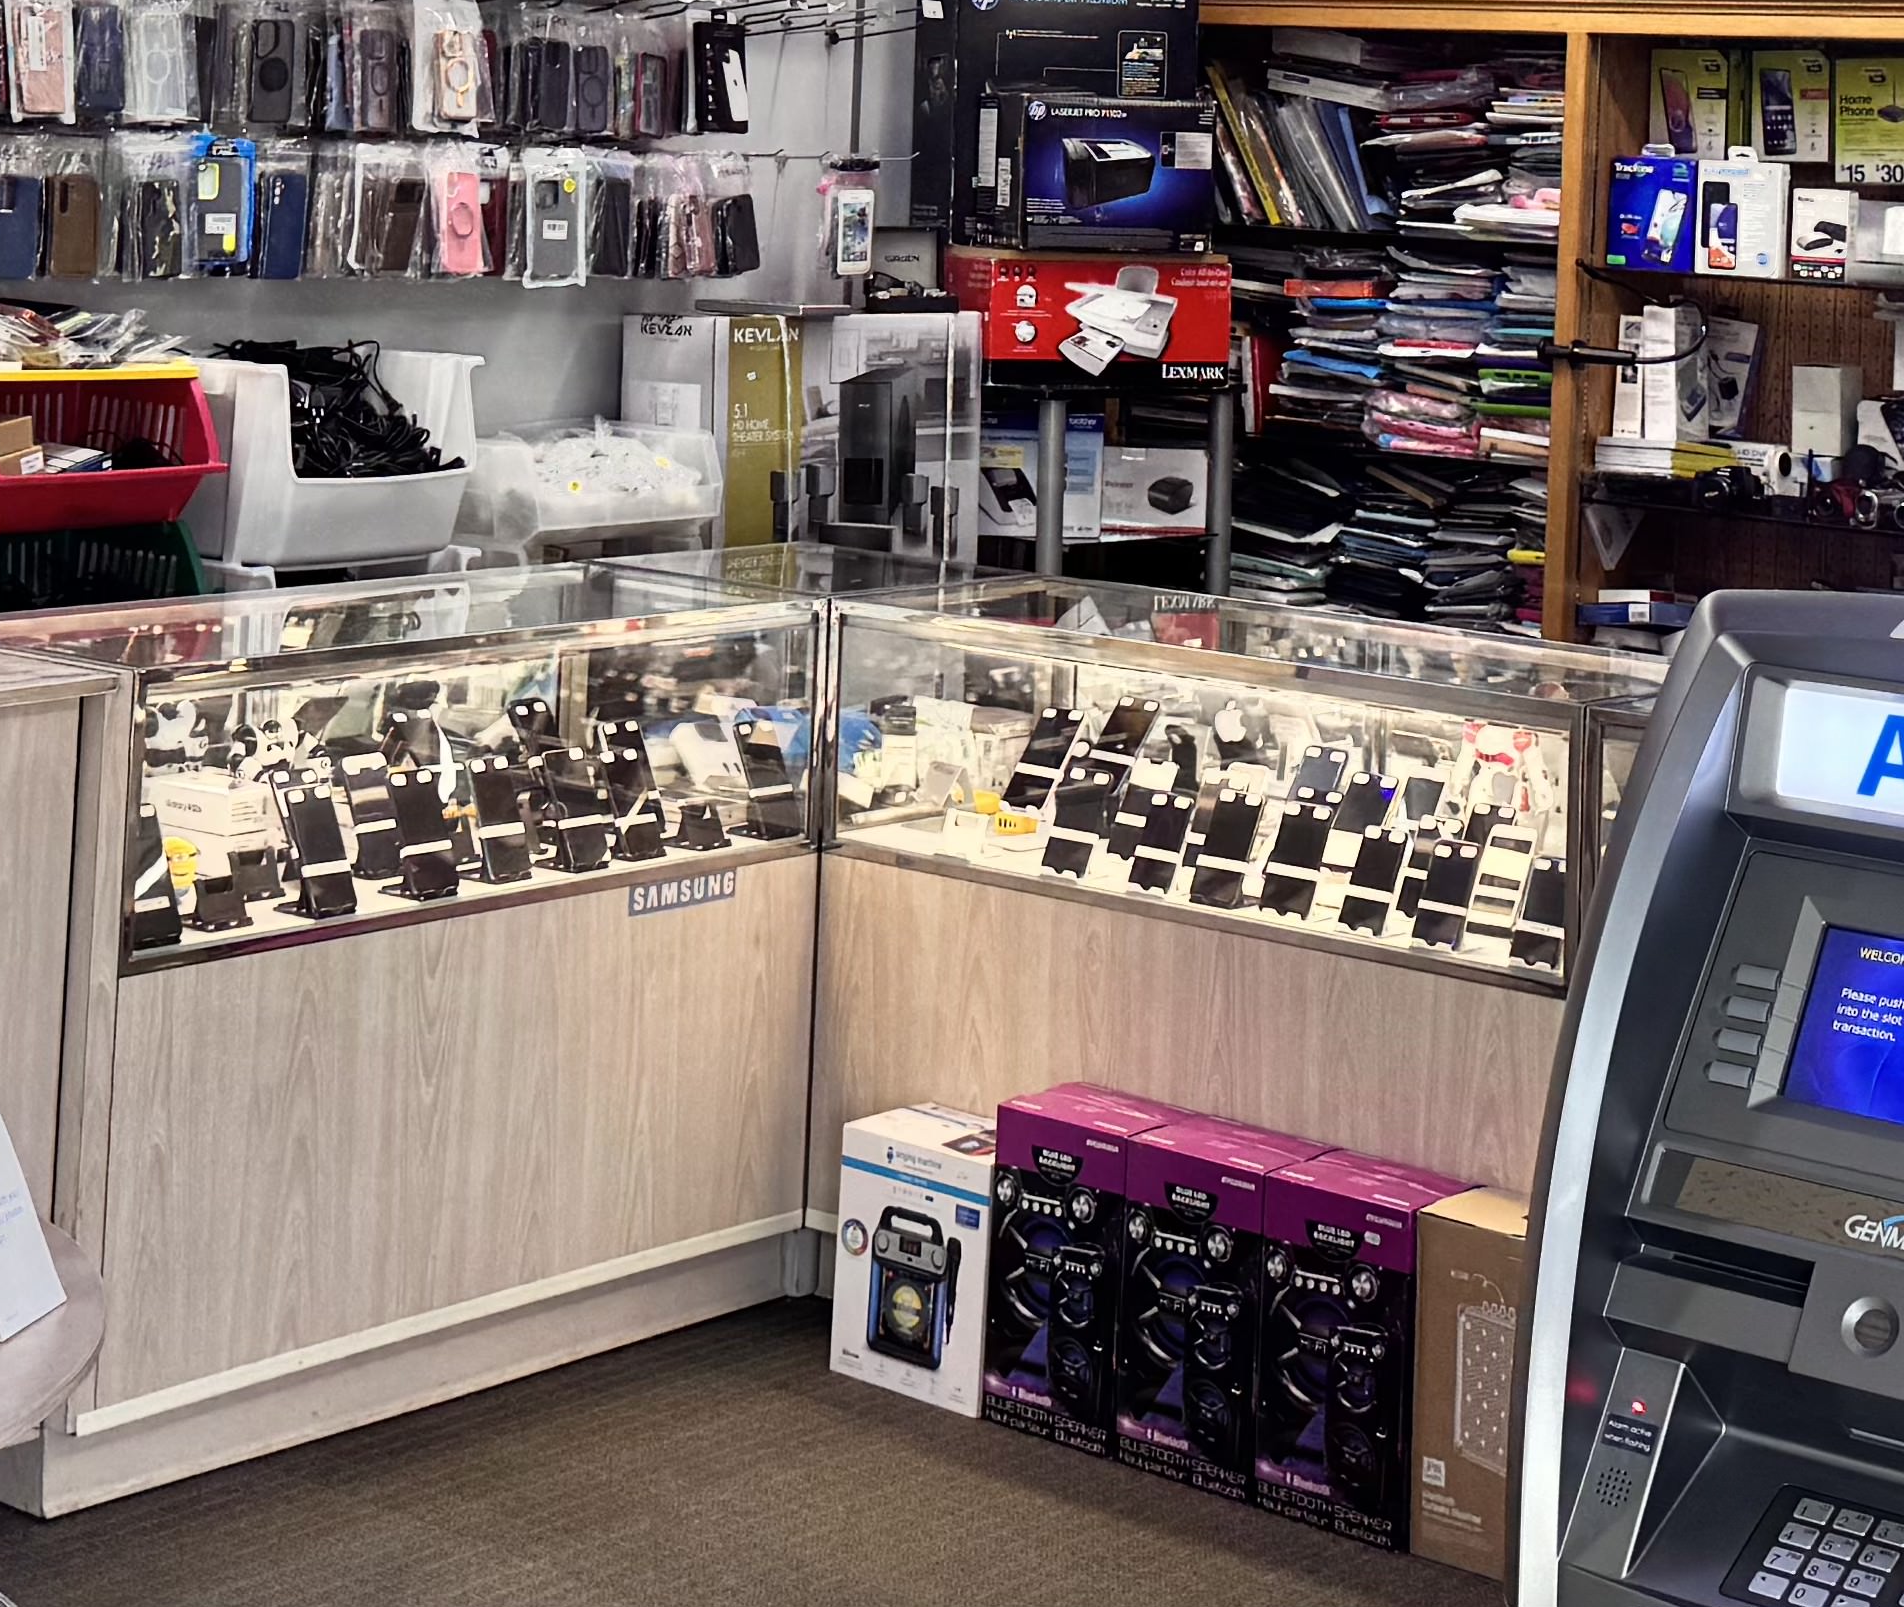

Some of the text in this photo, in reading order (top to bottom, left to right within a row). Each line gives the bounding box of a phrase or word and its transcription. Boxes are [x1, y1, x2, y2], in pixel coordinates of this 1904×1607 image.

[1840, 95, 1872, 106] Home
[1028, 101, 1047, 120] hp
[1840, 106, 1875, 117] Phone
[1841, 164, 1904, 183] $15 $30
[1161, 364, 1224, 380] LEXMARK
[765, 430, 794, 443] SYSTM
[633, 871, 735, 911] SAMSUNG
[1840, 986, 1877, 1006] Please
[1836, 1004, 1859, 1021] into
[1861, 1007, 1880, 1023] the
[1881, 1011, 1904, 1028] slot
[1832, 1019, 1897, 1044] transaction.
